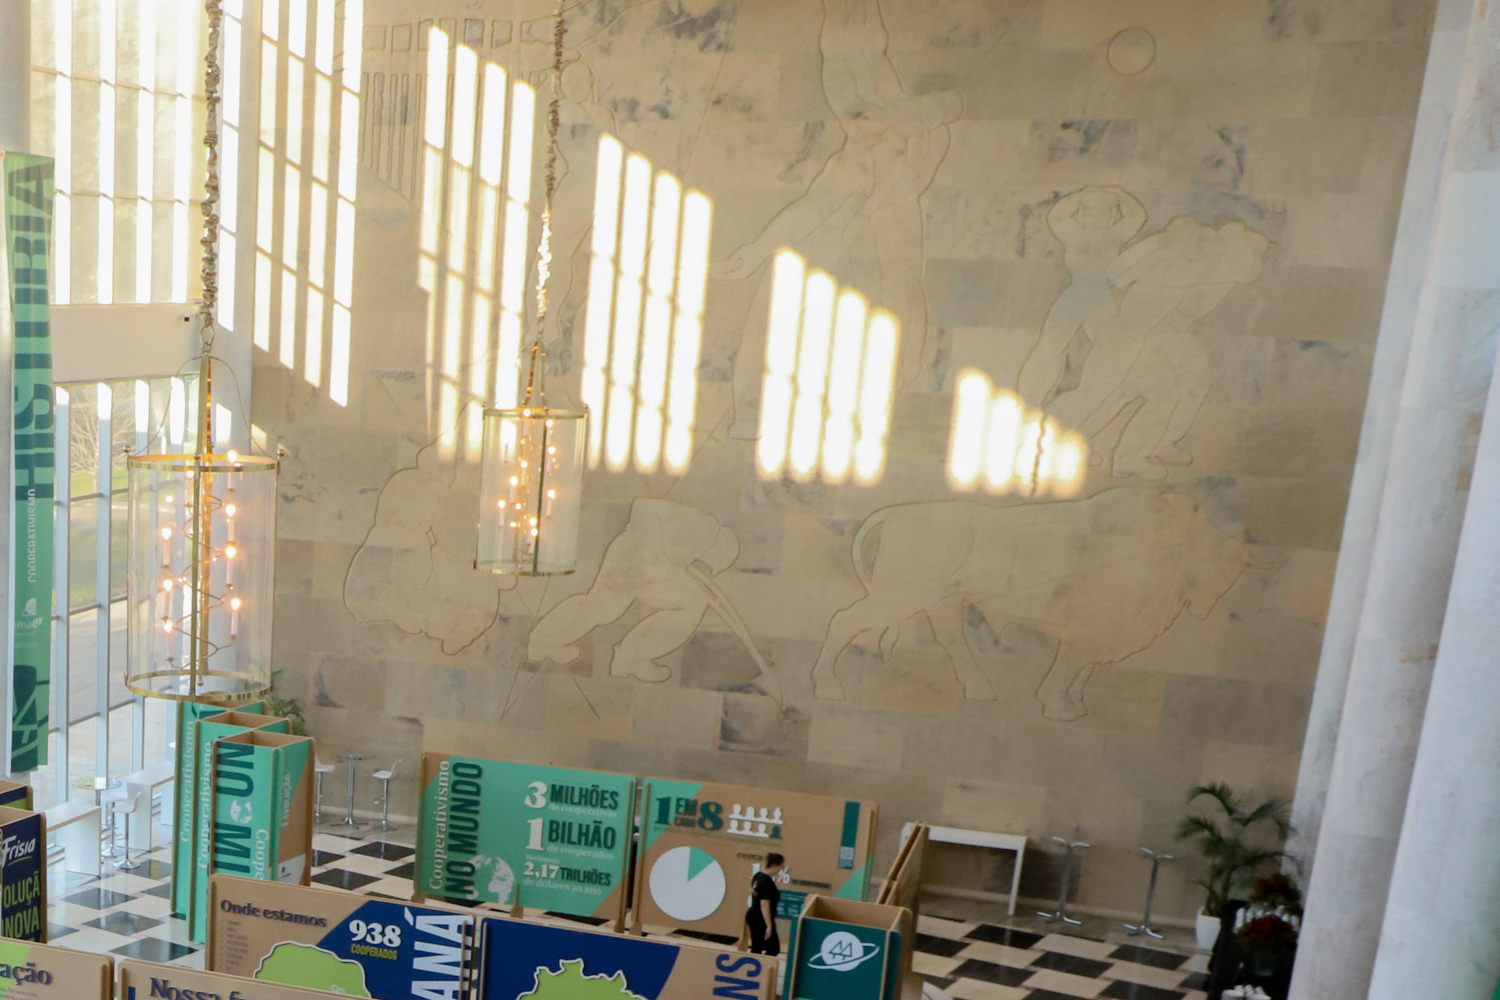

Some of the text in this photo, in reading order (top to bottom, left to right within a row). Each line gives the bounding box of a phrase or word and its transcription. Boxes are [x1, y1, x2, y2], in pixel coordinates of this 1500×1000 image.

[524, 781, 619, 810] 3 MILHÕES
[429, 760, 450, 890] Cooperativismo
[654, 796, 671, 825] 1
[697, 801, 723, 831] 8
[445, 762, 484, 895] NO MUNDO
[526, 818, 544, 851] 1
[548, 819, 616, 850] BILHÃO
[524, 861, 612, 887] 2,17 TRILHÕES
[220, 899, 327, 928] Onde estamos
[349, 919, 402, 948] 938
[351, 943, 398, 961] COOPERADOS
